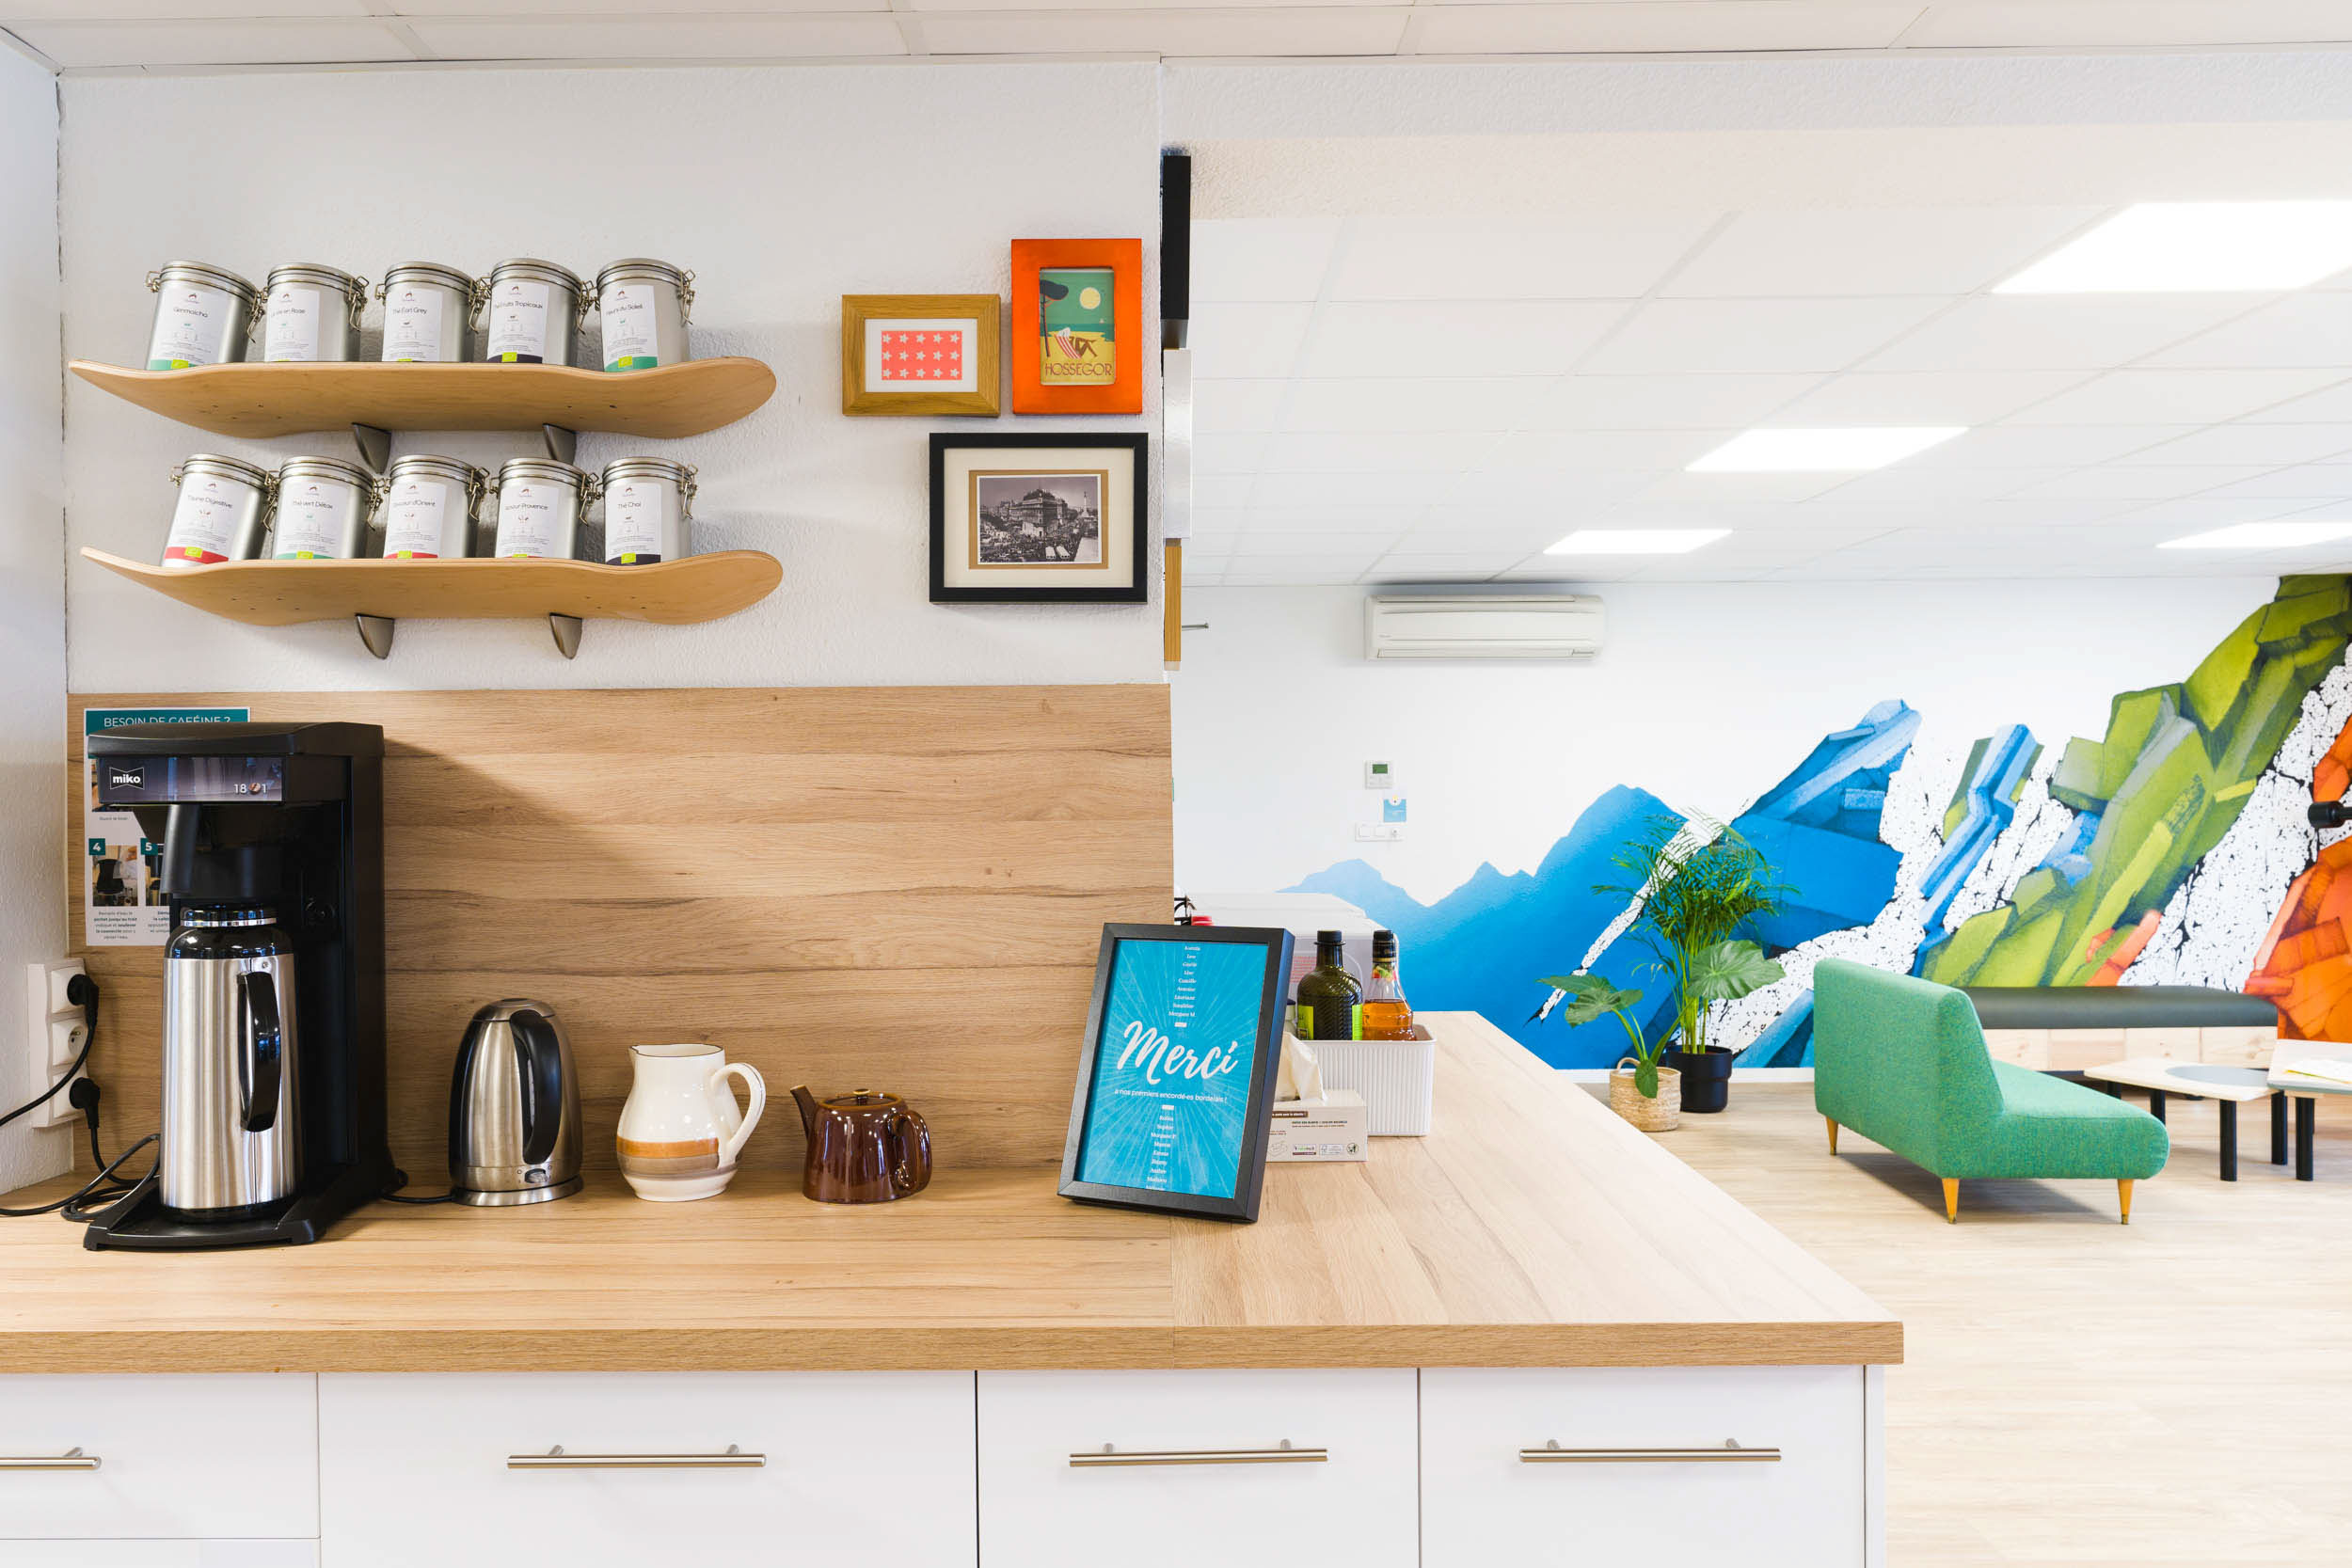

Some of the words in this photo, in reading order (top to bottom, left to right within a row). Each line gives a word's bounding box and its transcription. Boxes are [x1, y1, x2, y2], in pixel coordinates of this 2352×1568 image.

[515, 300, 543, 309] Tropicaux
[413, 307, 428, 315] Grey
[1045, 362, 1113, 376] HOSSEGOR
[521, 502, 548, 511] Provence
[113, 774, 141, 784] miko
[92, 843, 101, 851] 4
[145, 842, 152, 851] 5
[1117, 1021, 1239, 1085] Merci
[1132, 1090, 1159, 1099] premiers
